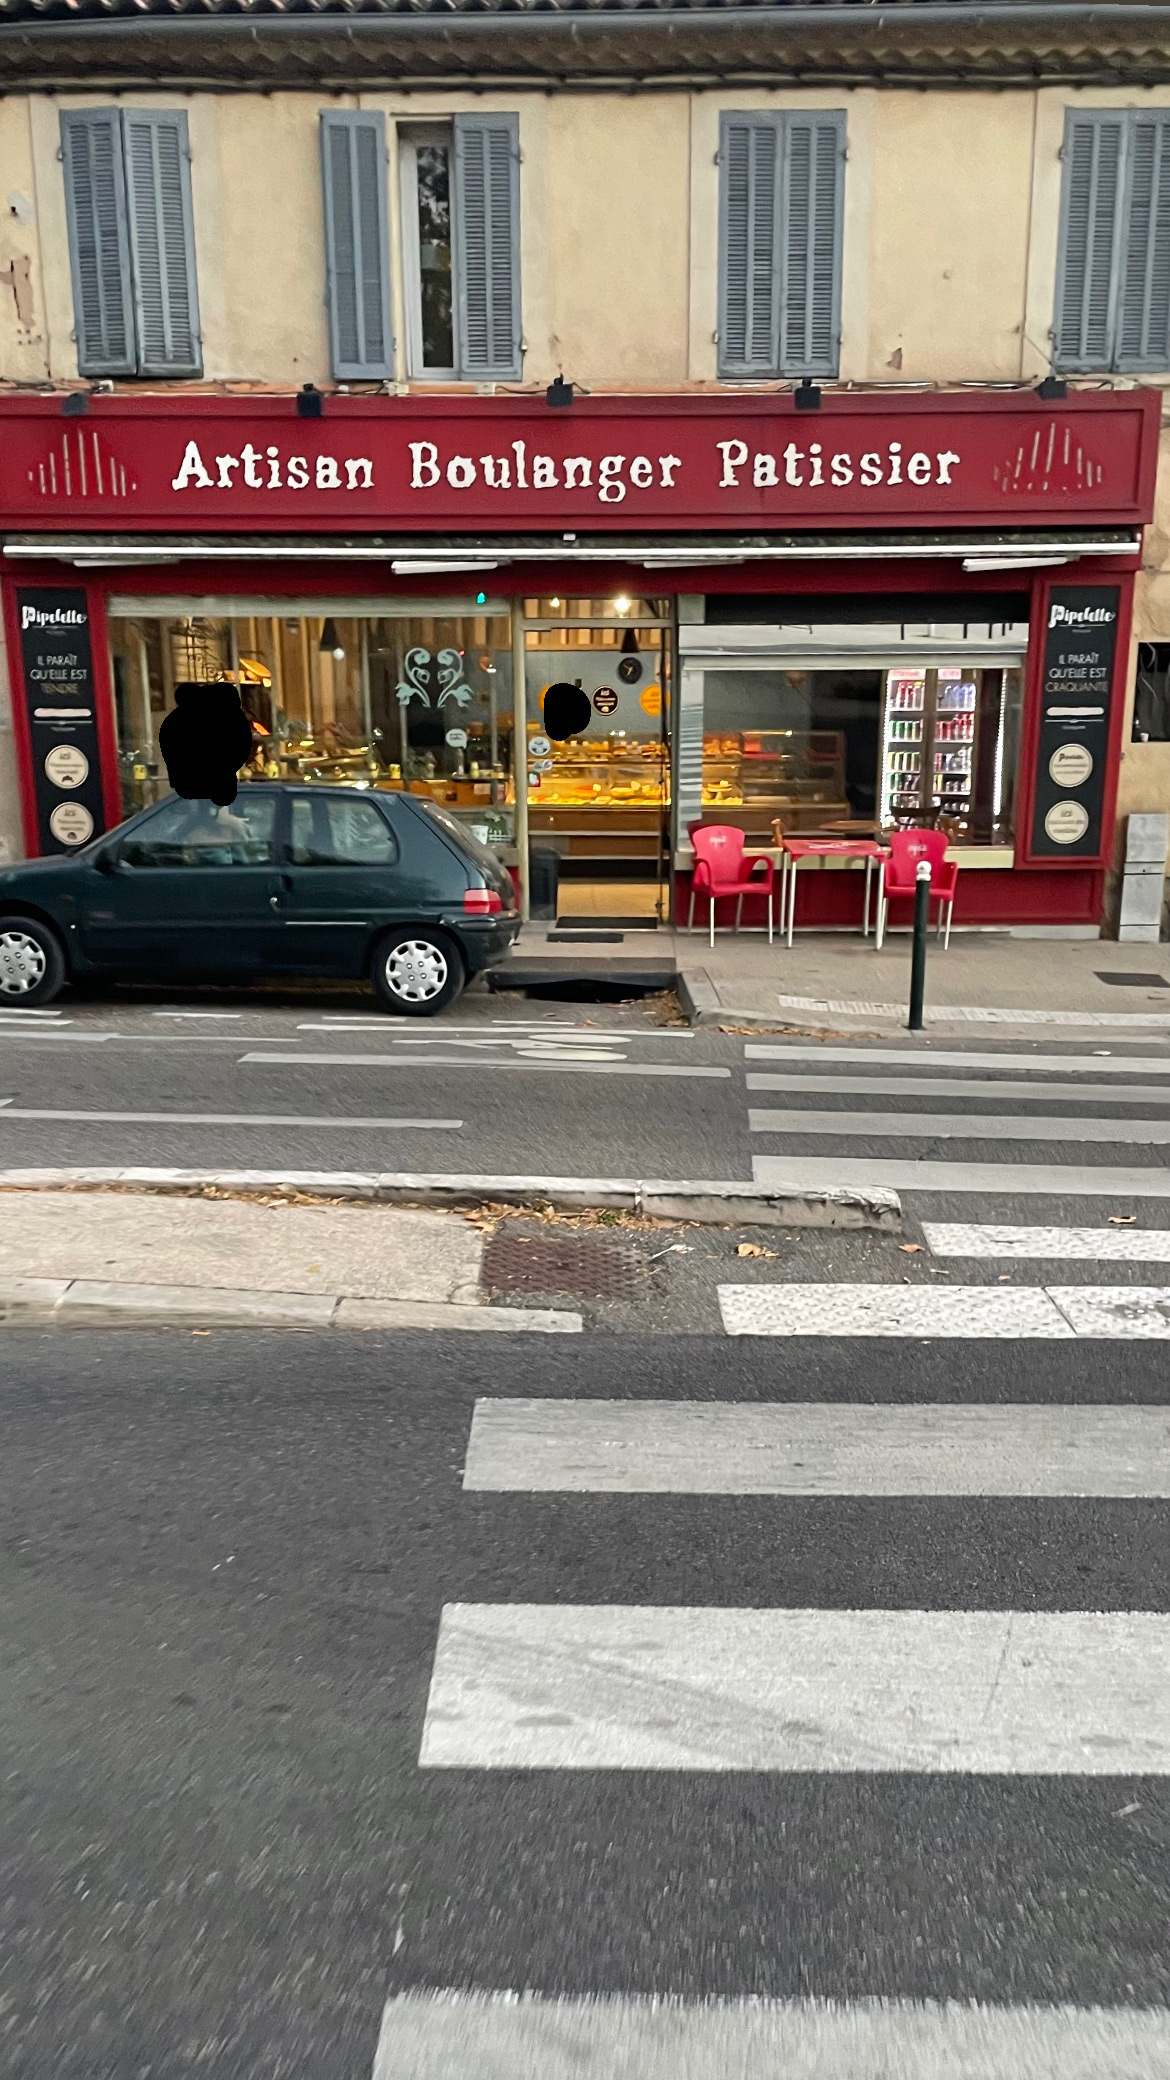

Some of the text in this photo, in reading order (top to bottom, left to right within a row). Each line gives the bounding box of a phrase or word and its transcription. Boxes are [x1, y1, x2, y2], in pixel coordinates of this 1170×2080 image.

[171, 438, 961, 503] Artisan Boulanger Patissier
[21, 605, 87, 629] Pipelette
[1048, 604, 1116, 628] Pipelette
[70, 669, 87, 680] EST
[1089, 667, 1107, 678] EST
[1045, 681, 1109, 693] CRAQUANTE
